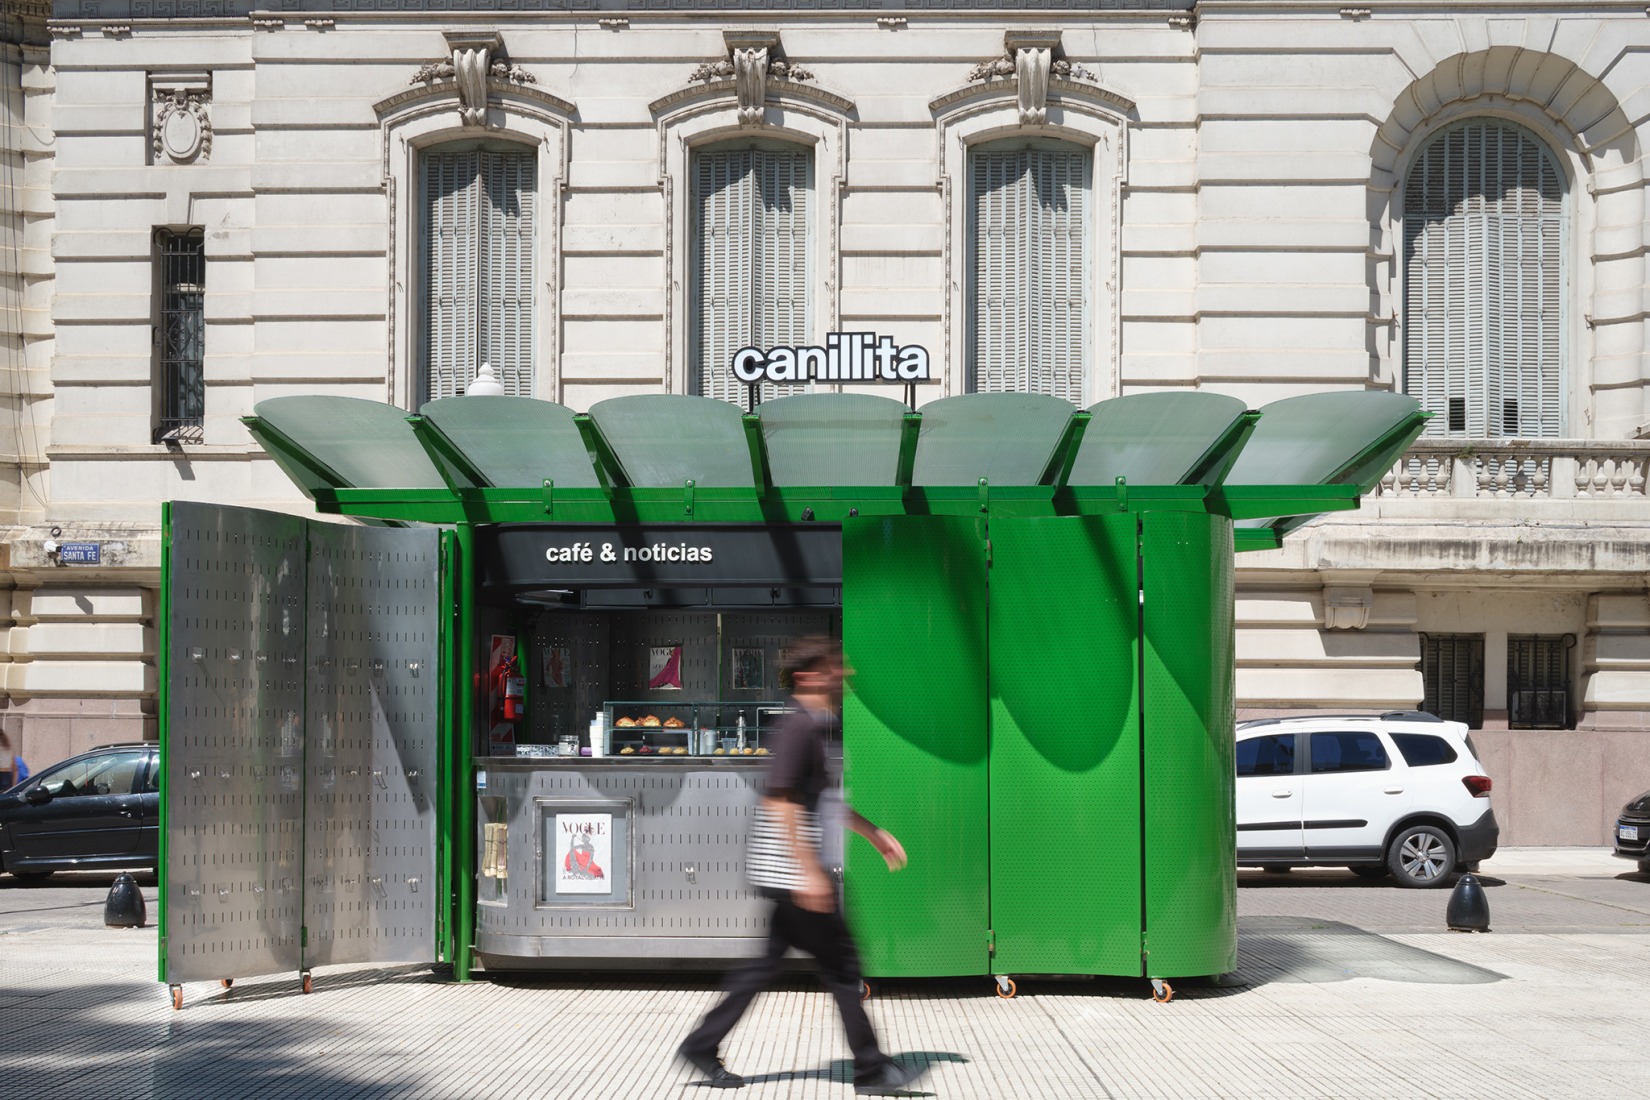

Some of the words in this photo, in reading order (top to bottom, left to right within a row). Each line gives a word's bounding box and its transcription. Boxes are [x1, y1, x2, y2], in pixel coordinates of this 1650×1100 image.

[732, 332, 930, 384] canillita
[63, 551, 85, 561] SANTA
[87, 551, 97, 561] FE
[546, 543, 593, 562] café
[600, 543, 617, 562] &
[624, 543, 713, 562] noticias
[562, 822, 605, 835] VOGUE
